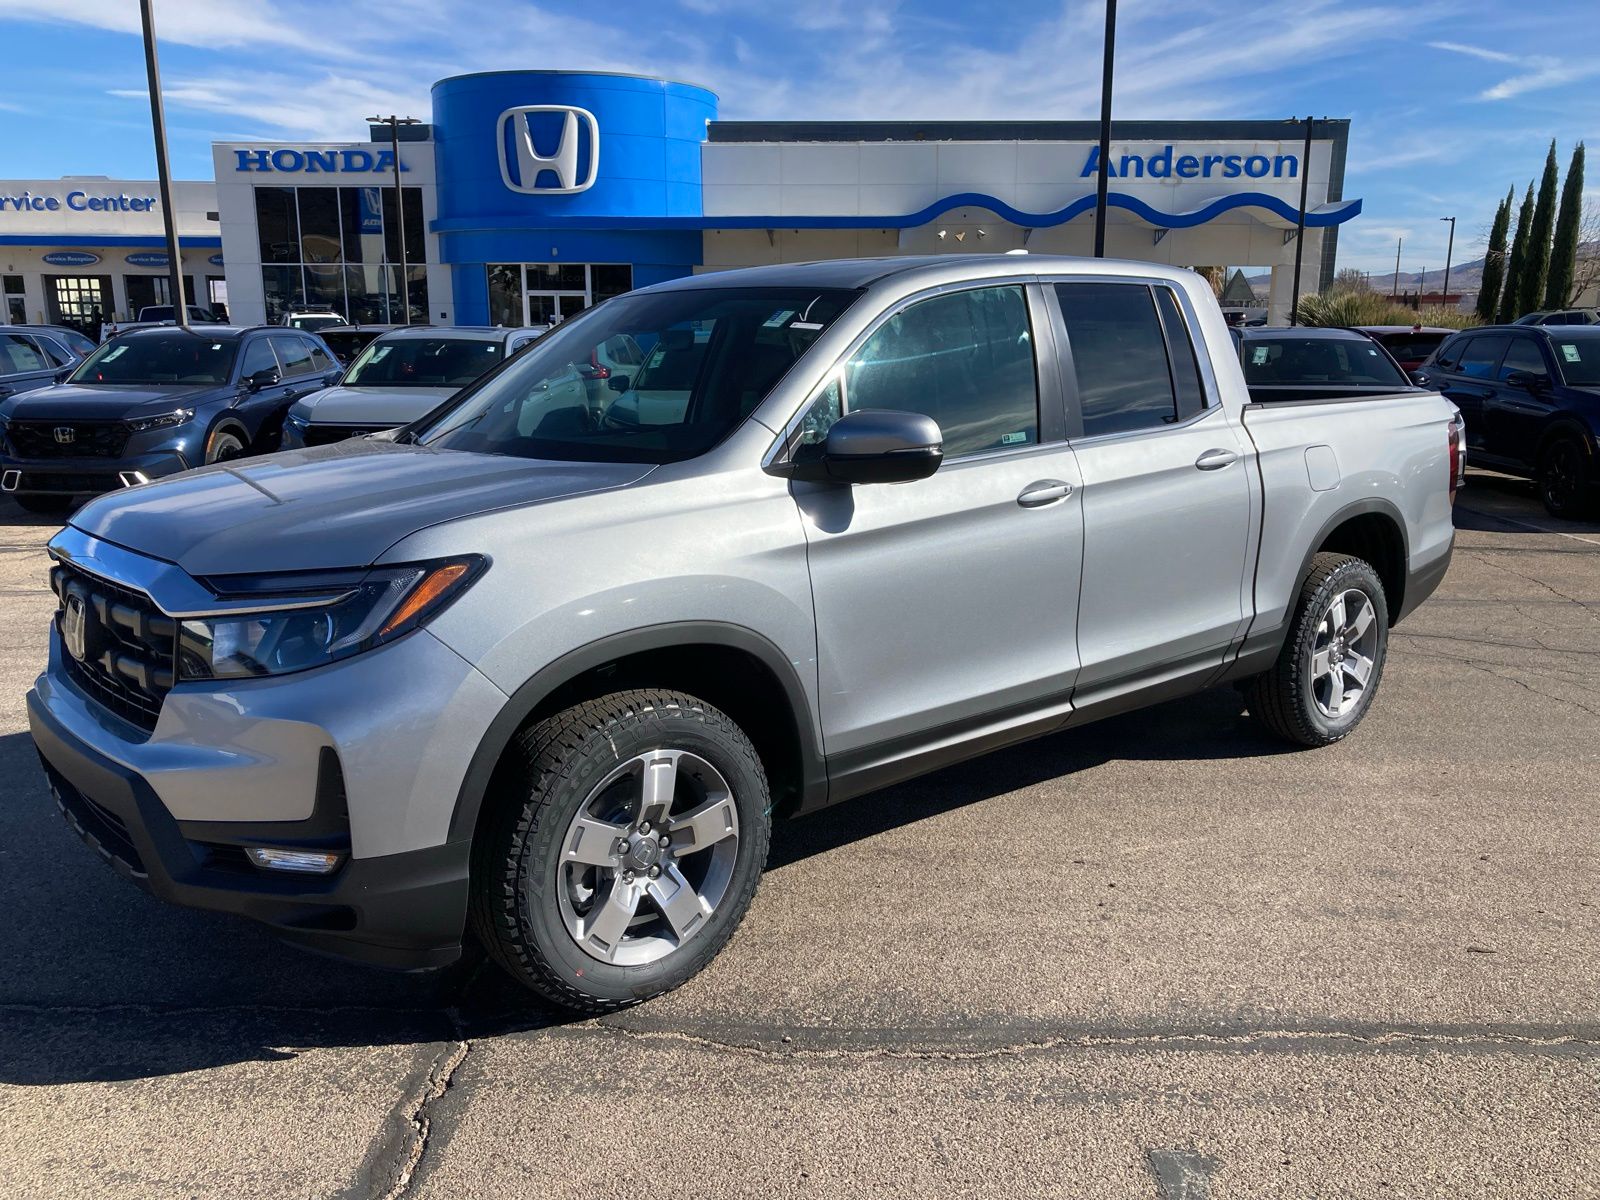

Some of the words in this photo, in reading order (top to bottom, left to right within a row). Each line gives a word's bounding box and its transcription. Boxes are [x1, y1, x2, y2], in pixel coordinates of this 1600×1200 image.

[234, 149, 410, 173] HONDA
[1080, 145, 1299, 178] Anderson
[66, 191, 157, 212] Center
